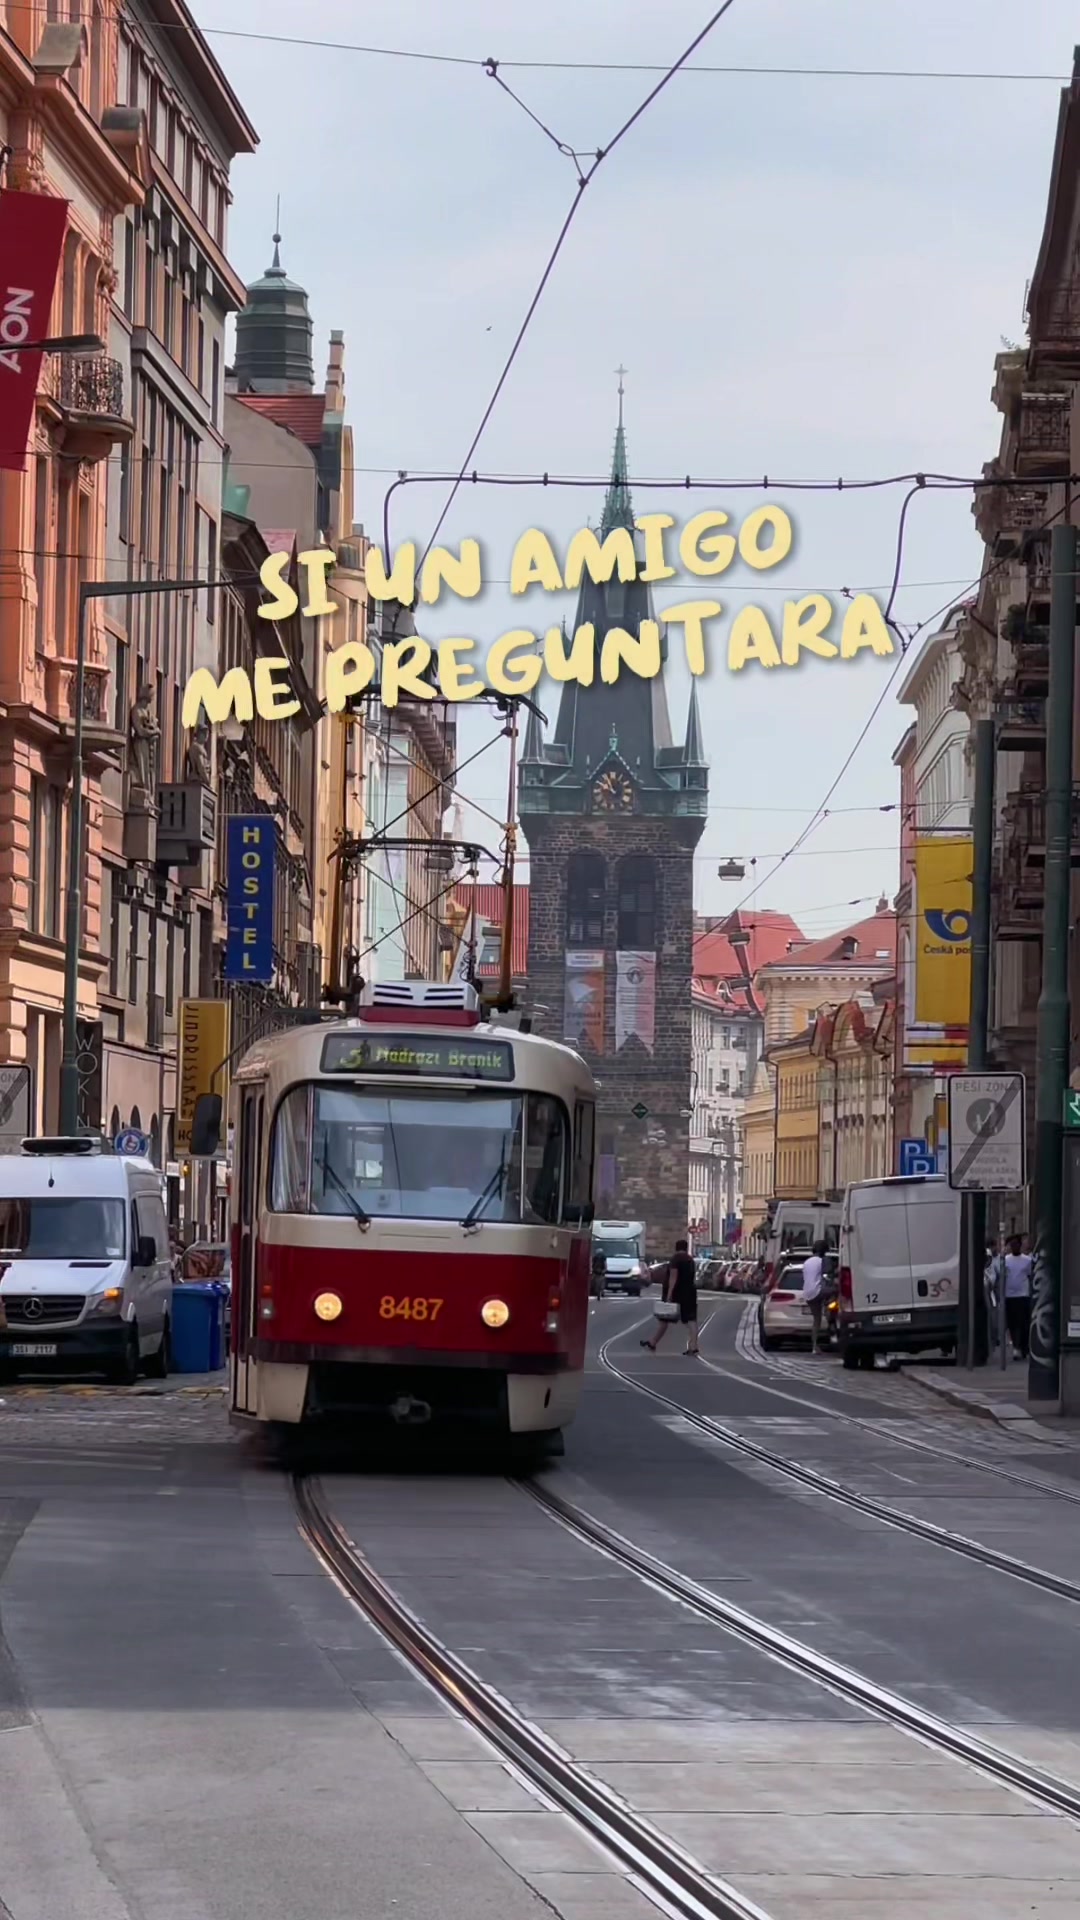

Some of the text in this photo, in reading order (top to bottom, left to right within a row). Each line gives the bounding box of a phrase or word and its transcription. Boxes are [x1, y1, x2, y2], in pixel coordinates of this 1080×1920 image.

[0, 287, 34, 374] AON
[242, 826, 261, 969] HOSTEL
[924, 943, 953, 954] Česká
[904, 1142, 921, 1174] P
[912, 1159, 930, 1174] P
[379, 1295, 444, 1321] 8487
[866, 1293, 879, 1304] 12
